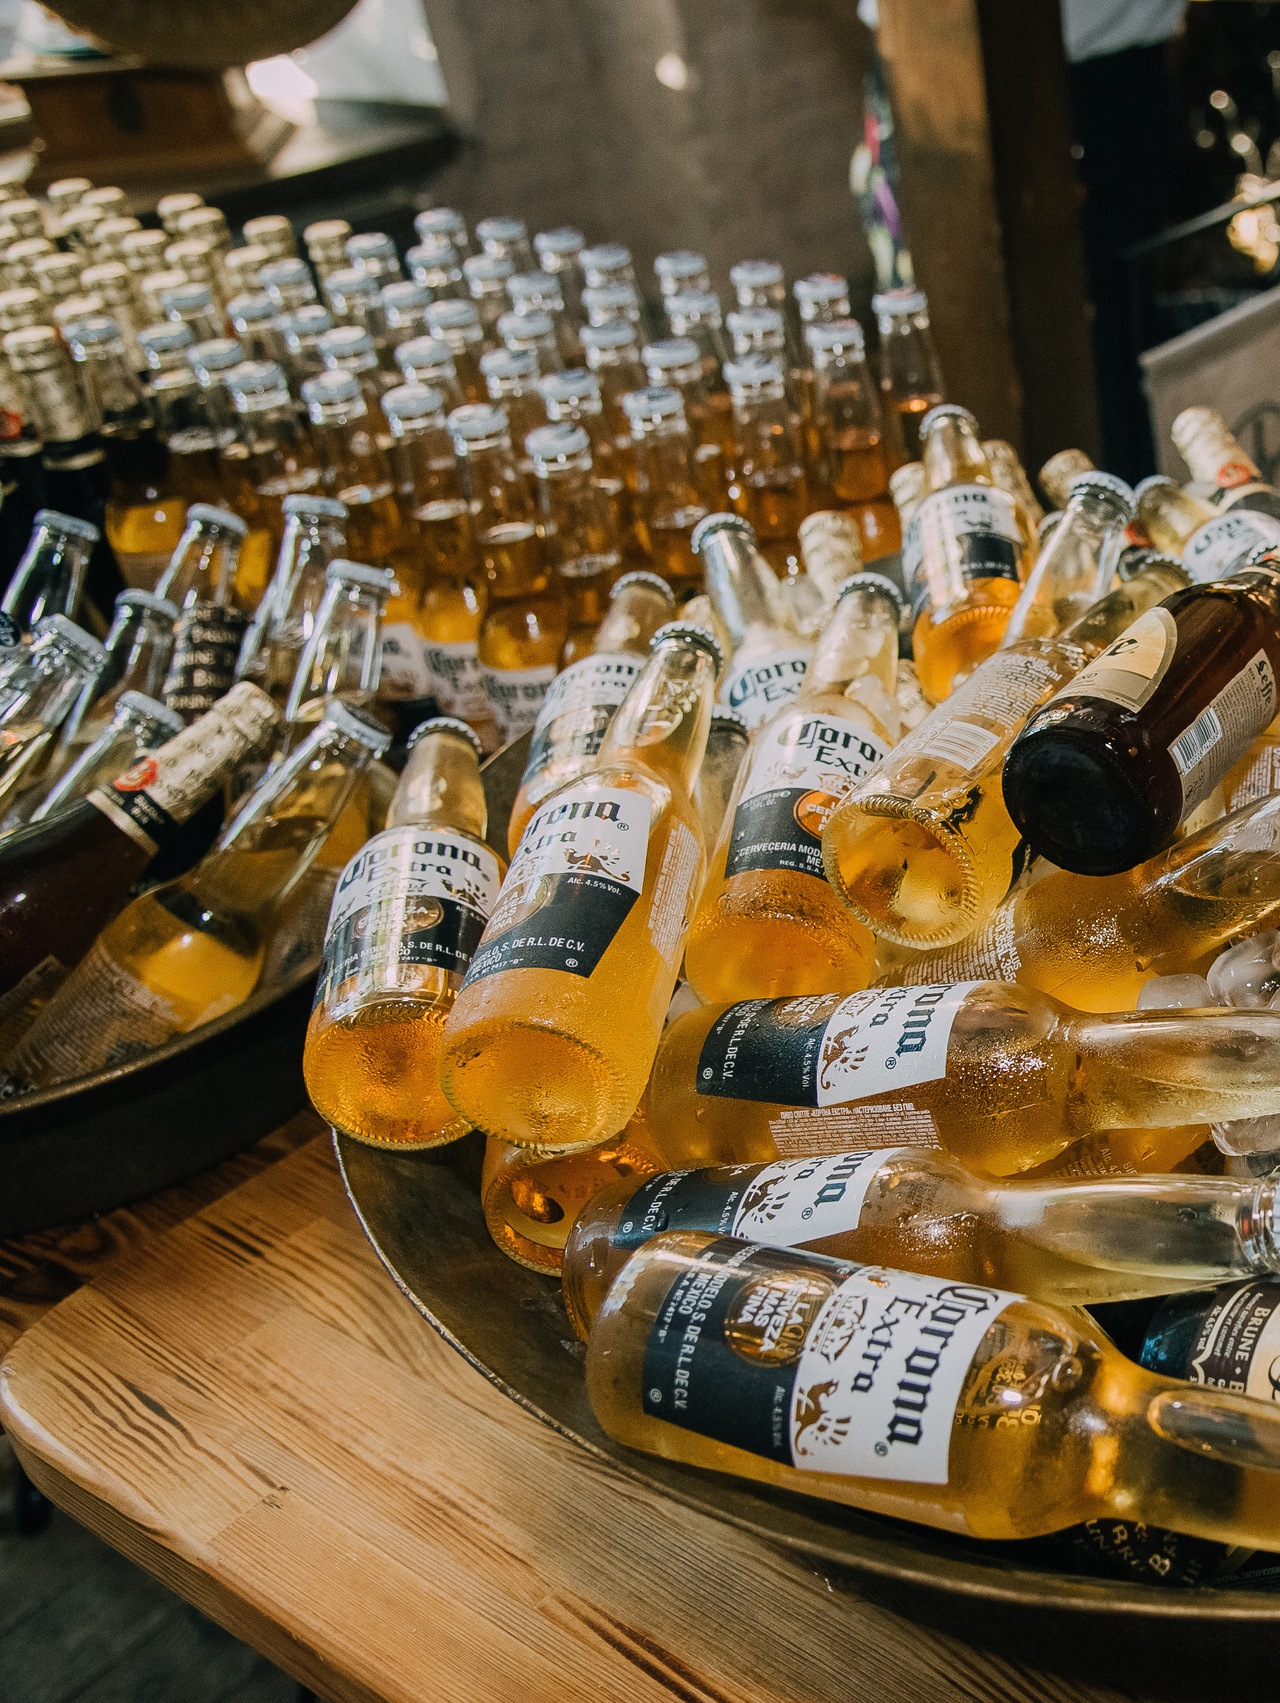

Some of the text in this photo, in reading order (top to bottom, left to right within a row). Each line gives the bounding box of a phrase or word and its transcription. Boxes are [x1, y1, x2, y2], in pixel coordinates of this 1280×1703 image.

[730, 660, 807, 708] Coro
[777, 719, 884, 763] Coro
[814, 745, 868, 778] Ext
[607, 885, 622, 896] Vol.
[419, 942, 434, 951] DE
[512, 937, 527, 949] DE
[549, 936, 564, 948] DE
[565, 939, 585, 952] C.V.
[725, 1046, 738, 1060] DE
[722, 1061, 735, 1080] C.V.
[647, 1201, 663, 1214] DE
[640, 1215, 656, 1233] C.V.
[678, 1272, 713, 1316] MEXICO
[737, 1285, 770, 1324] FINA
[753, 1290, 785, 1327] MAS
[682, 1325, 702, 1344] DE
[851, 1296, 928, 1393] Extra
[1235, 1307, 1272, 1361] BRUNE
[676, 1344, 696, 1370] R.L.
[886, 1285, 999, 1445] Corona
[674, 1369, 690, 1388] DE
